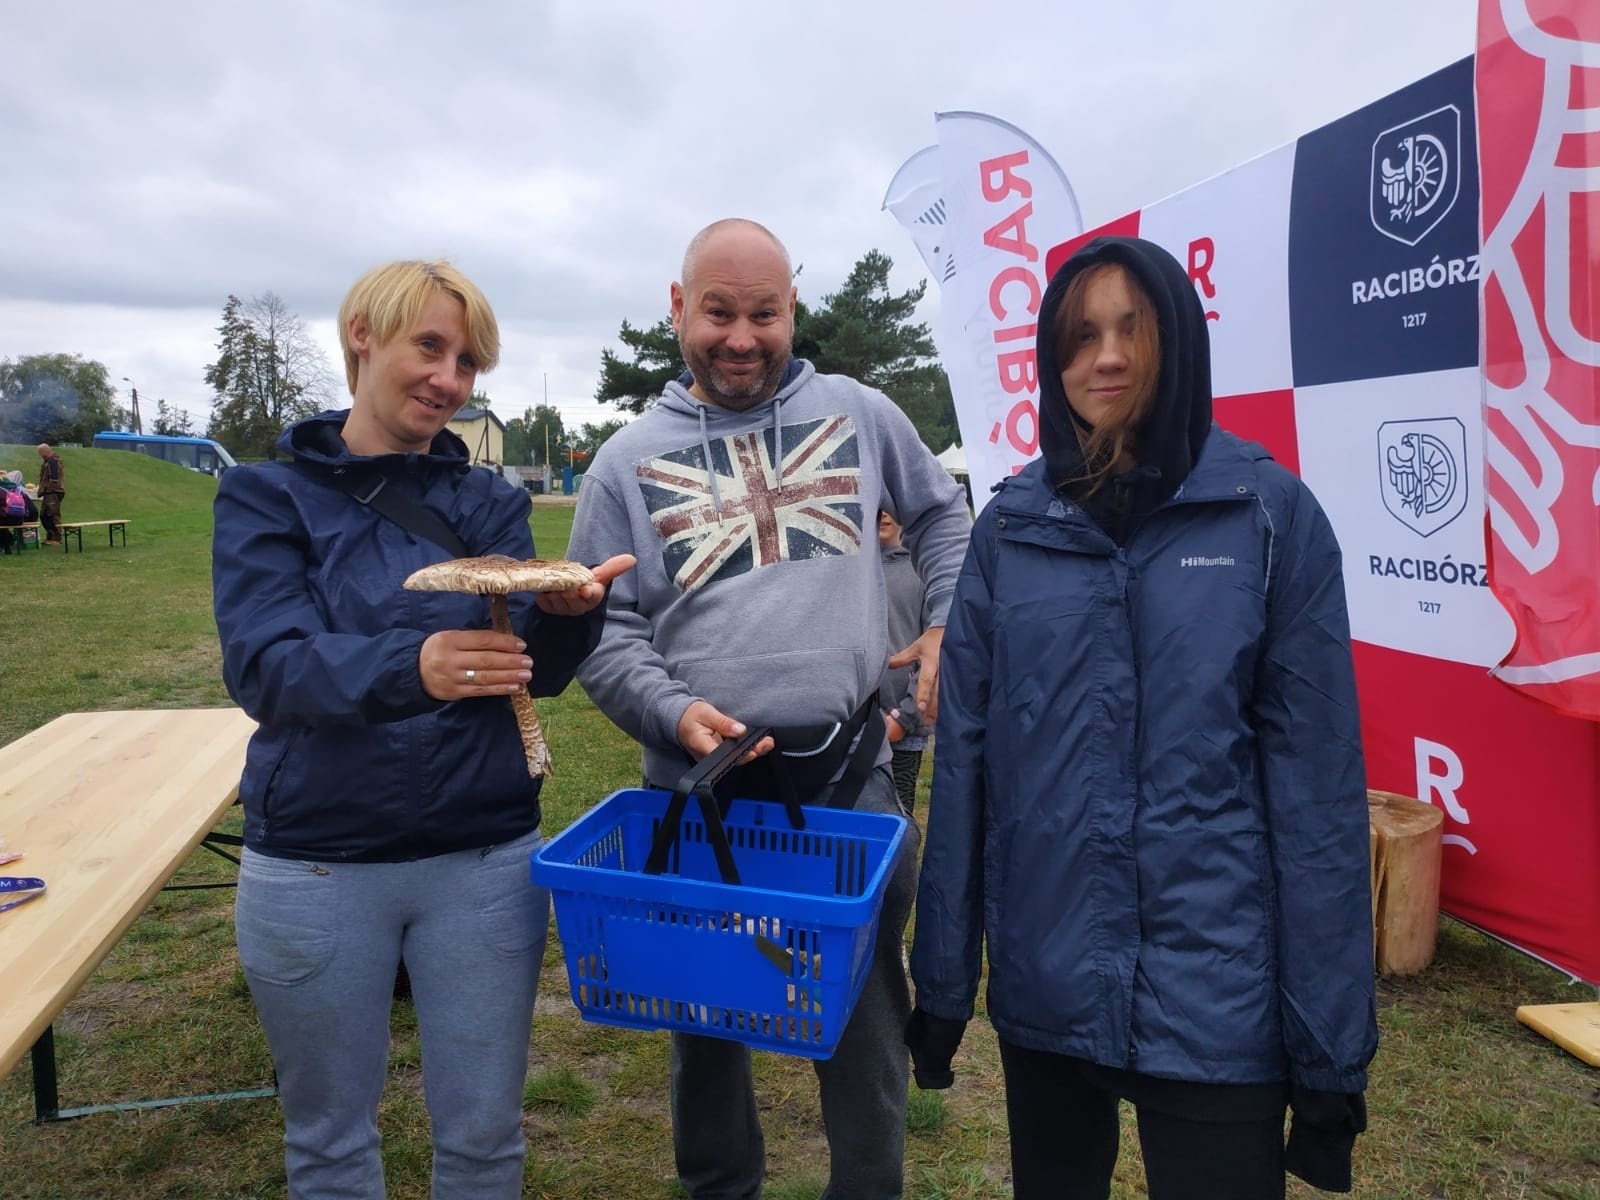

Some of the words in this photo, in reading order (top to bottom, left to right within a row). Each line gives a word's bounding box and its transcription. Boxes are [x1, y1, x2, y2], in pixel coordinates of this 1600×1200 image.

[1352, 254, 1480, 304] RACIBÓRZ
[1402, 312, 1427, 328] 1217
[1369, 554, 1490, 587] RACIBÓRZ
[1418, 600, 1441, 614] 1217
[1414, 736, 1470, 825] R
